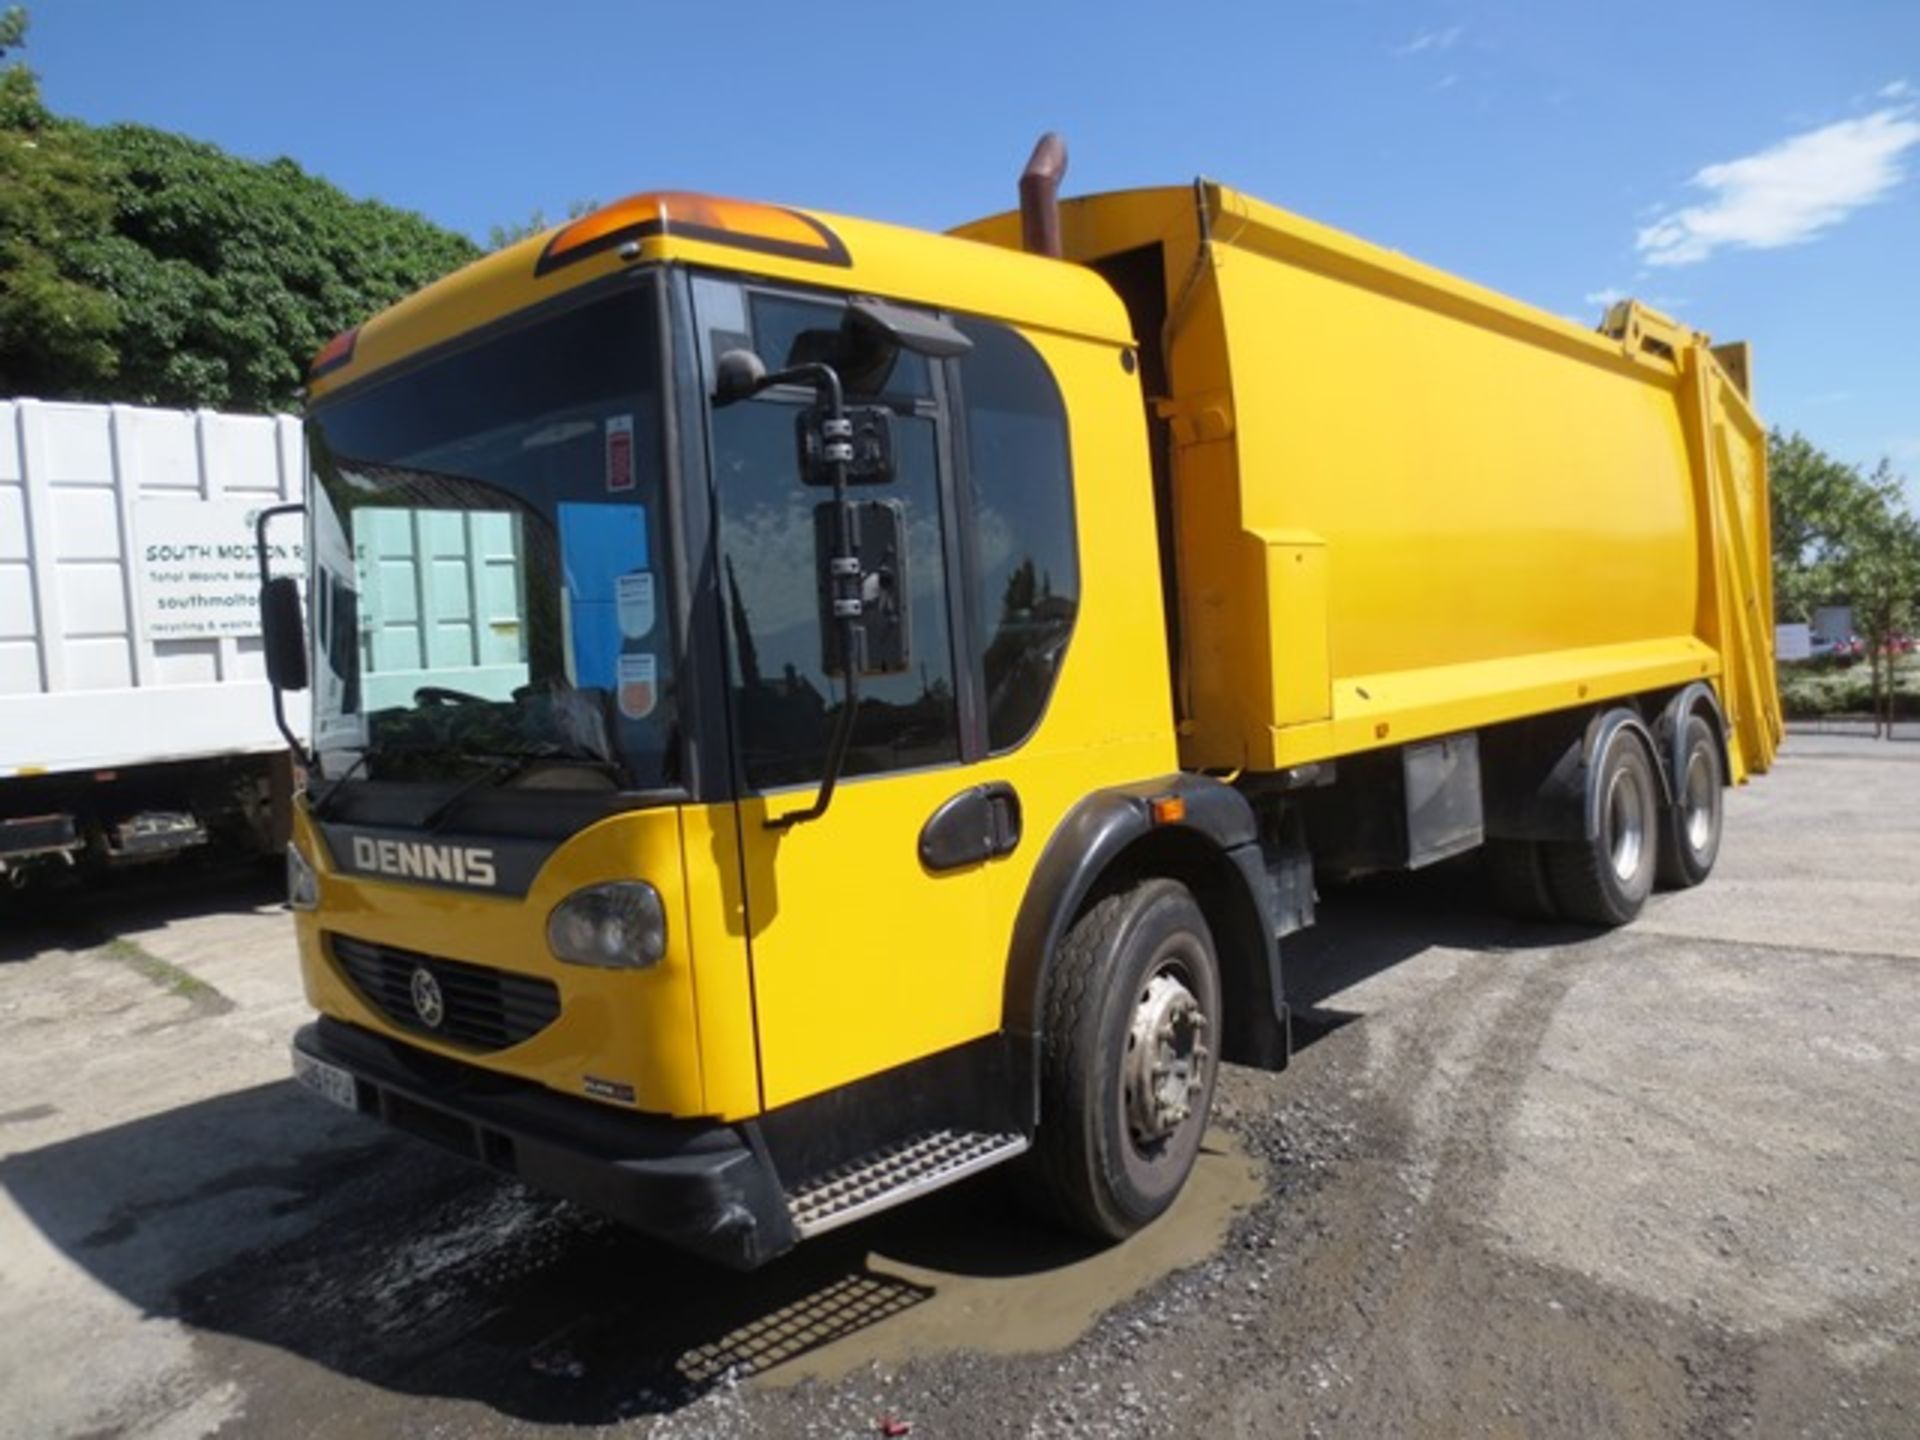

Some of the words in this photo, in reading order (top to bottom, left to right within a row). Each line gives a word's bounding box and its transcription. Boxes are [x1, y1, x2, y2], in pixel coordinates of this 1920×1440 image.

[146, 545, 212, 562] SOUTH
[188, 571, 230, 582] Waste
[207, 620, 216, 630] &
[352, 835, 497, 887] DENNIS
